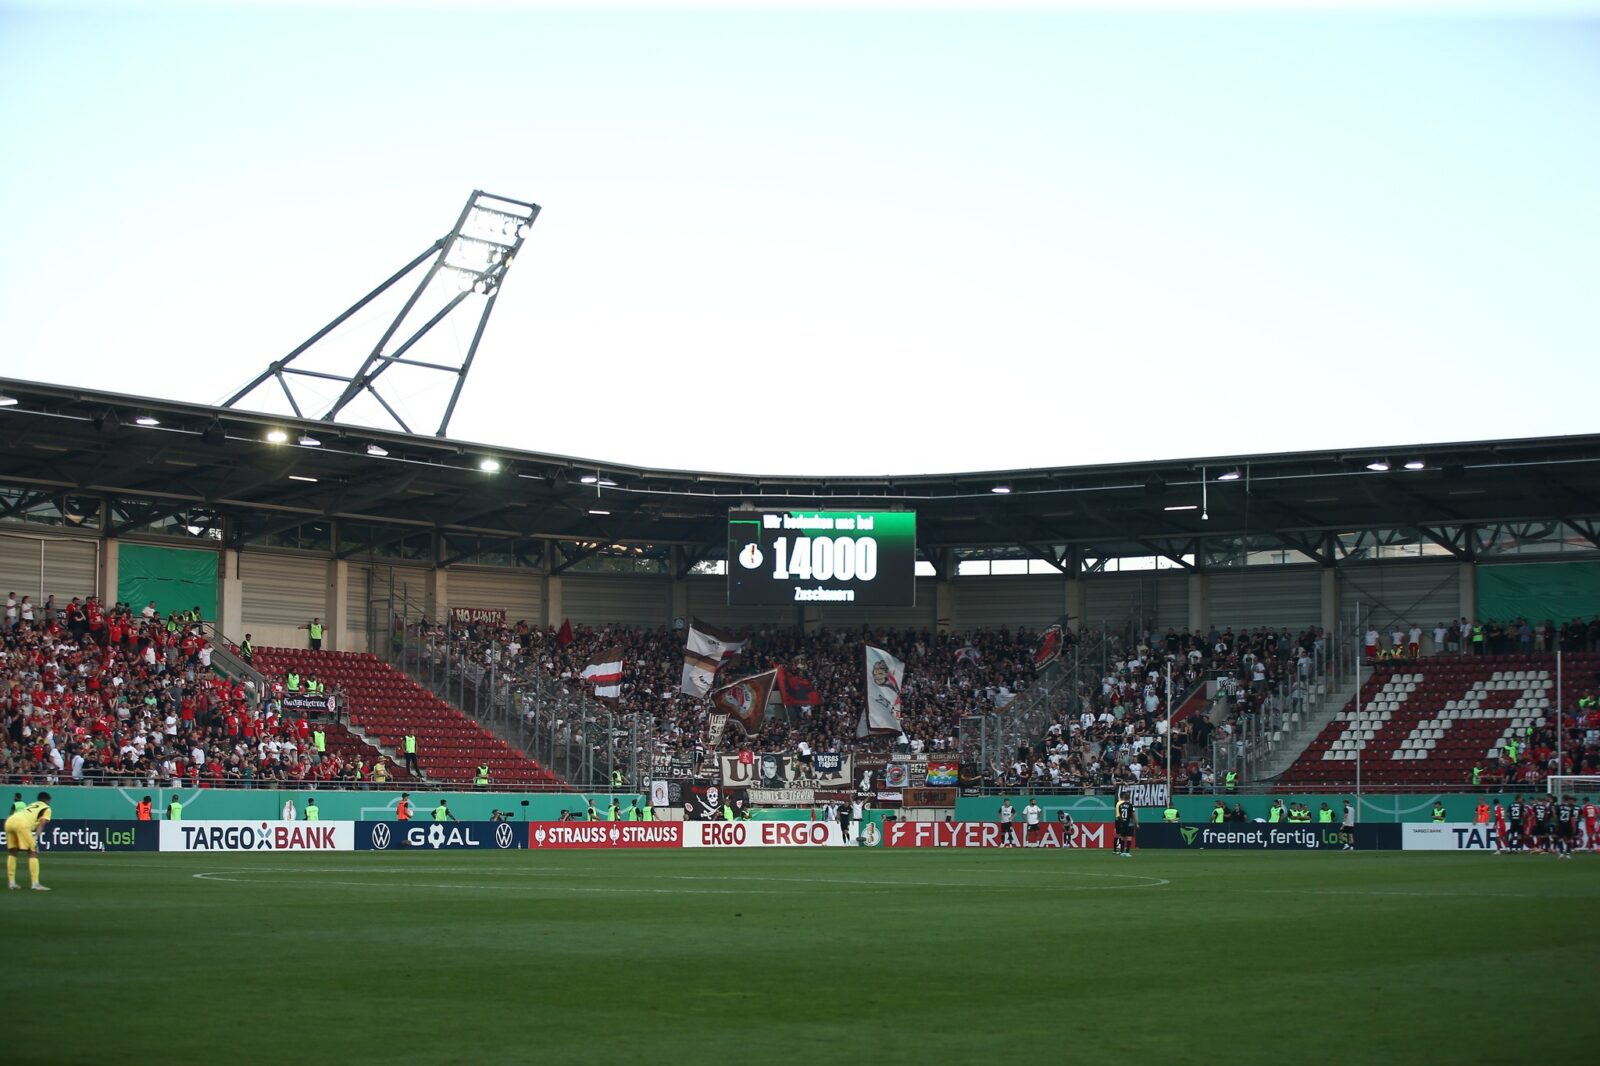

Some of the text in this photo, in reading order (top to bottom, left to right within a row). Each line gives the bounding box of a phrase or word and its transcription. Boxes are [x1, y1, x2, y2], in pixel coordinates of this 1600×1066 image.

[773, 536, 877, 581] 14000
[789, 780, 819, 789] PAULI
[53, 827, 103, 850] fertig,
[105, 827, 135, 845] los!
[549, 827, 678, 843] STRAUSS STRAUSS
[702, 823, 746, 846] ERGO
[761, 823, 829, 846] ERGO
[916, 823, 1104, 848] FLYERALARM
[1203, 829, 1268, 848] freenet,
[1270, 829, 1320, 848] fertig,
